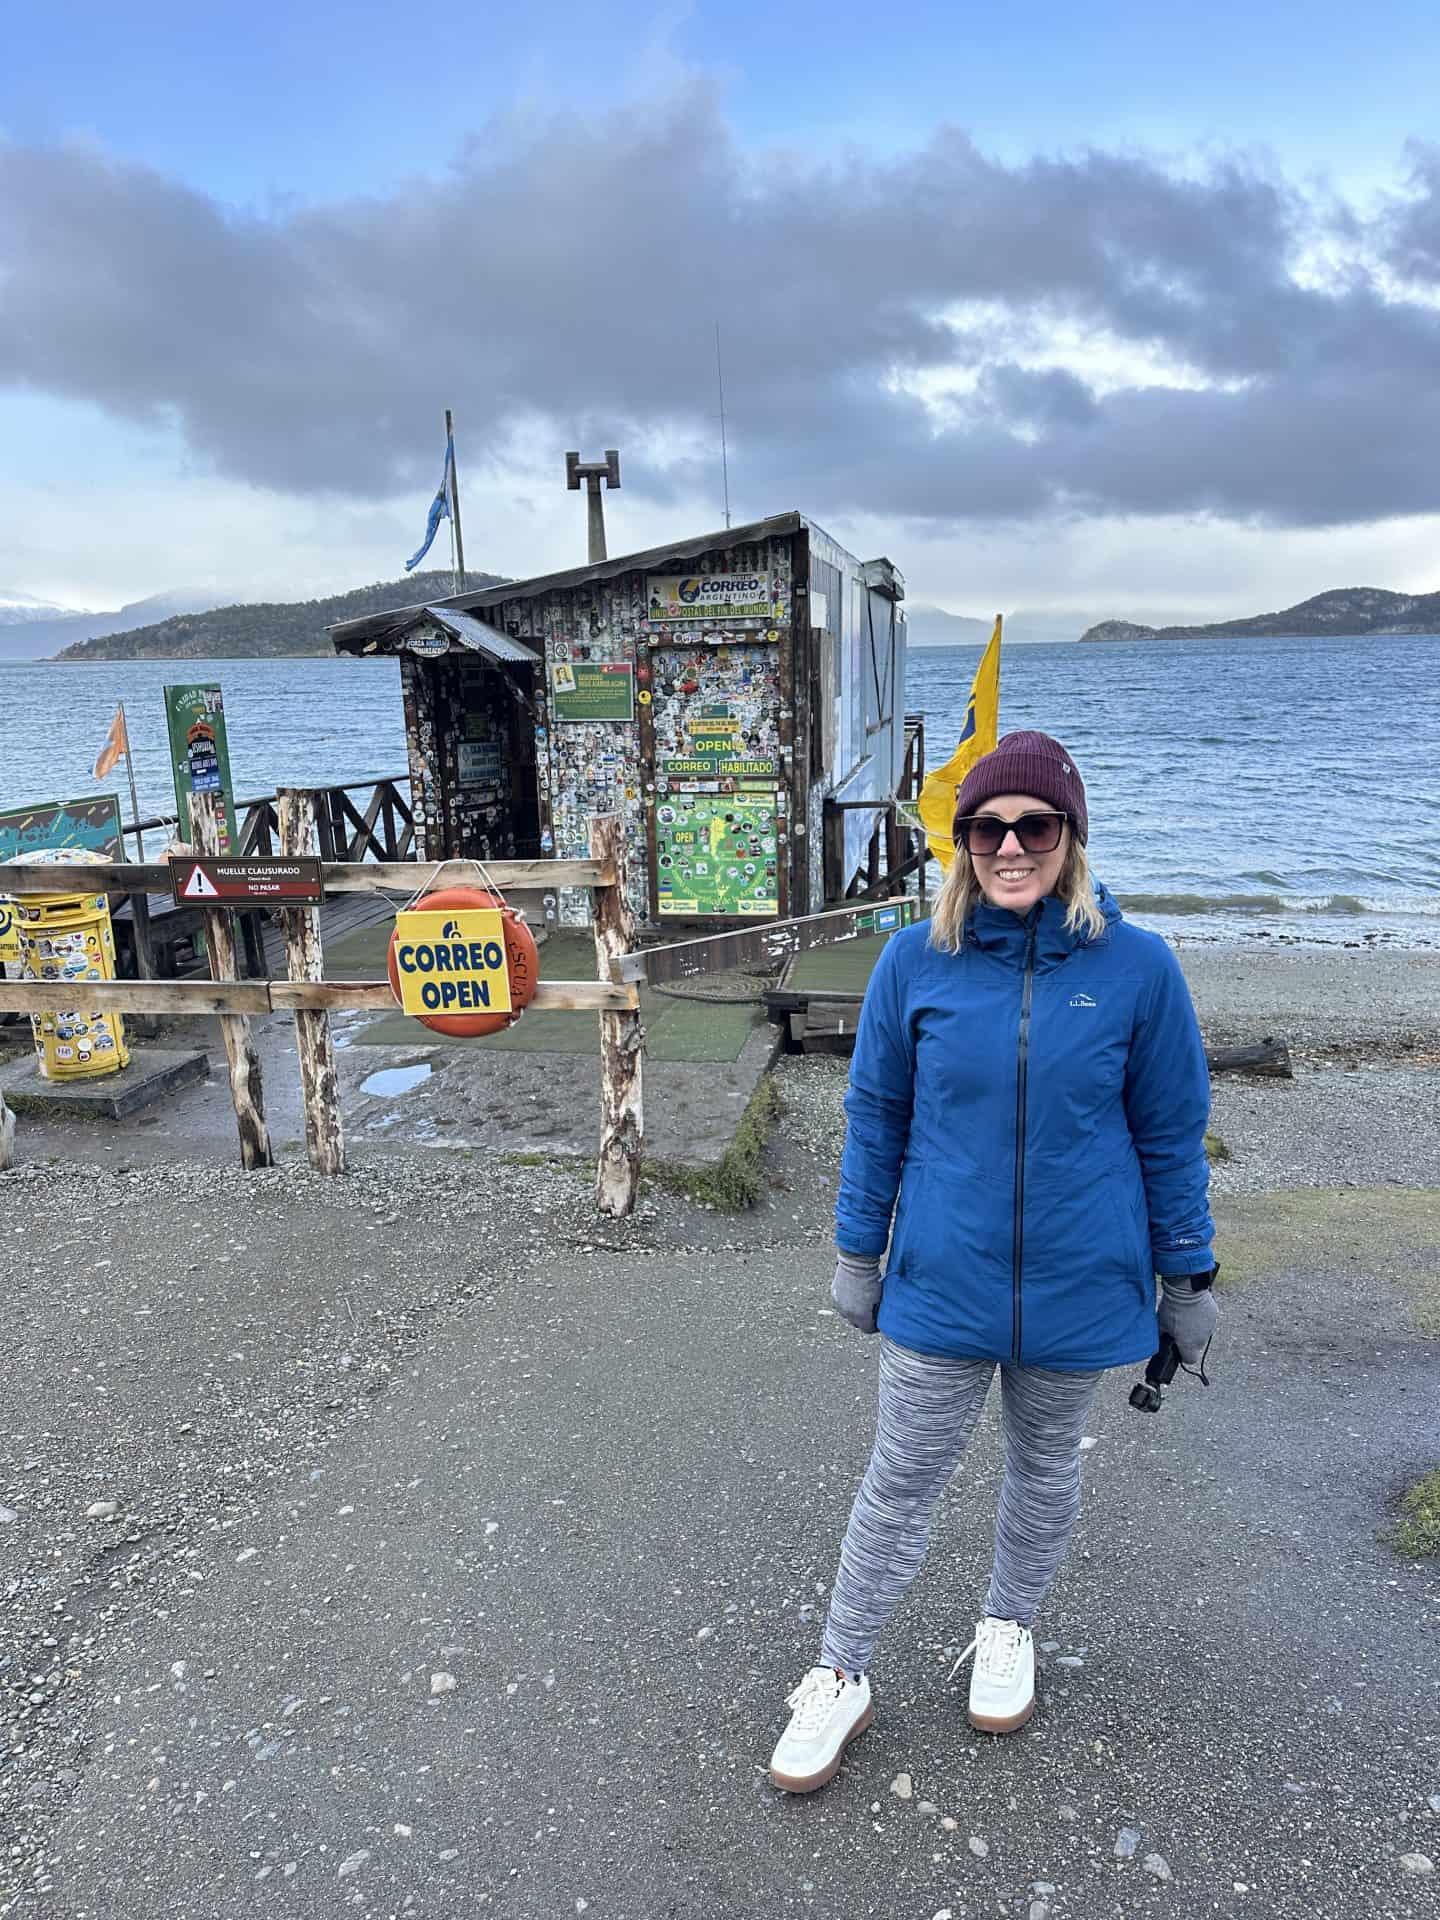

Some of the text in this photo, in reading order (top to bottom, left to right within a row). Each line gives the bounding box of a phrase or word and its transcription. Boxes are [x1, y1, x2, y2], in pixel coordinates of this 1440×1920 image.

[701, 579, 759, 593] CORREO
[700, 591, 756, 601] ARGENTINO
[695, 740, 732, 752] OPEN
[667, 761, 773, 773] CORREO HABILITADO
[675, 831, 695, 844] OPEN
[217, 867, 301, 875] MUELLE CLAUSURADO
[399, 941, 503, 973] CORREO
[421, 980, 490, 1009] OPEN
